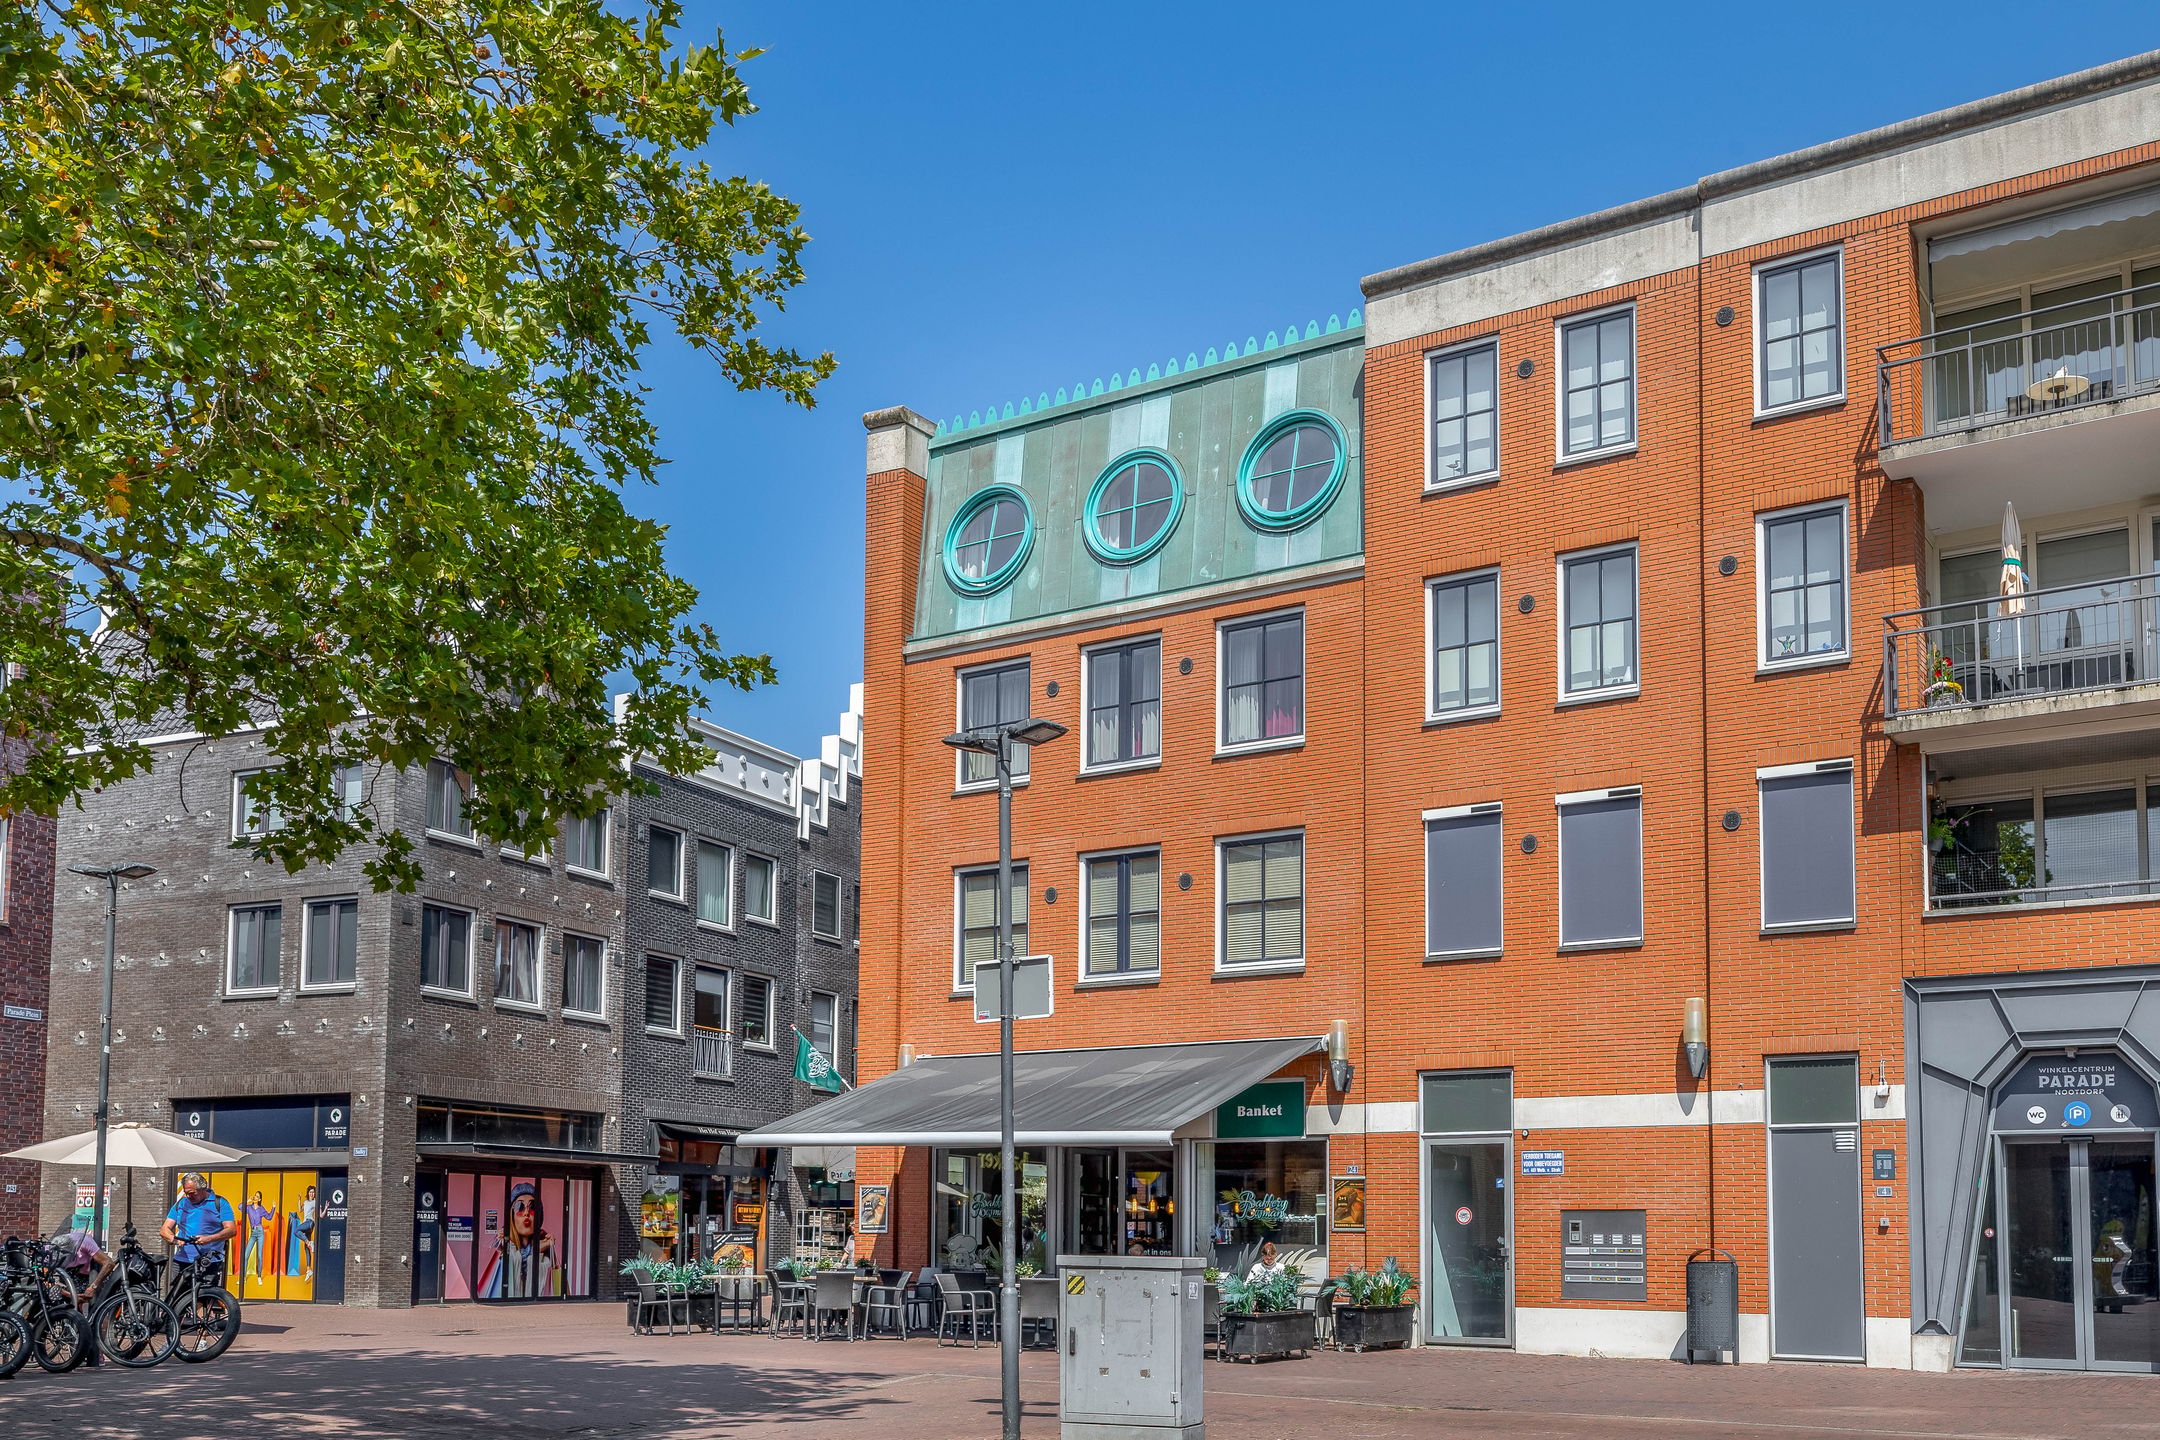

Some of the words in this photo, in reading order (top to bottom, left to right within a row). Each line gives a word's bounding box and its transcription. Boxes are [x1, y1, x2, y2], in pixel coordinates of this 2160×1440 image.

[7, 1008, 25, 1017] Parade
[26, 1010, 39, 1018] Plein
[2038, 1065, 2116, 1074] WINKELCENTRUM
[2038, 1074, 2116, 1089] PARADE
[2055, 1088, 2105, 1096] NOOTDORP
[1237, 1104, 1283, 1117] Banket
[2073, 1109, 2083, 1119] P
